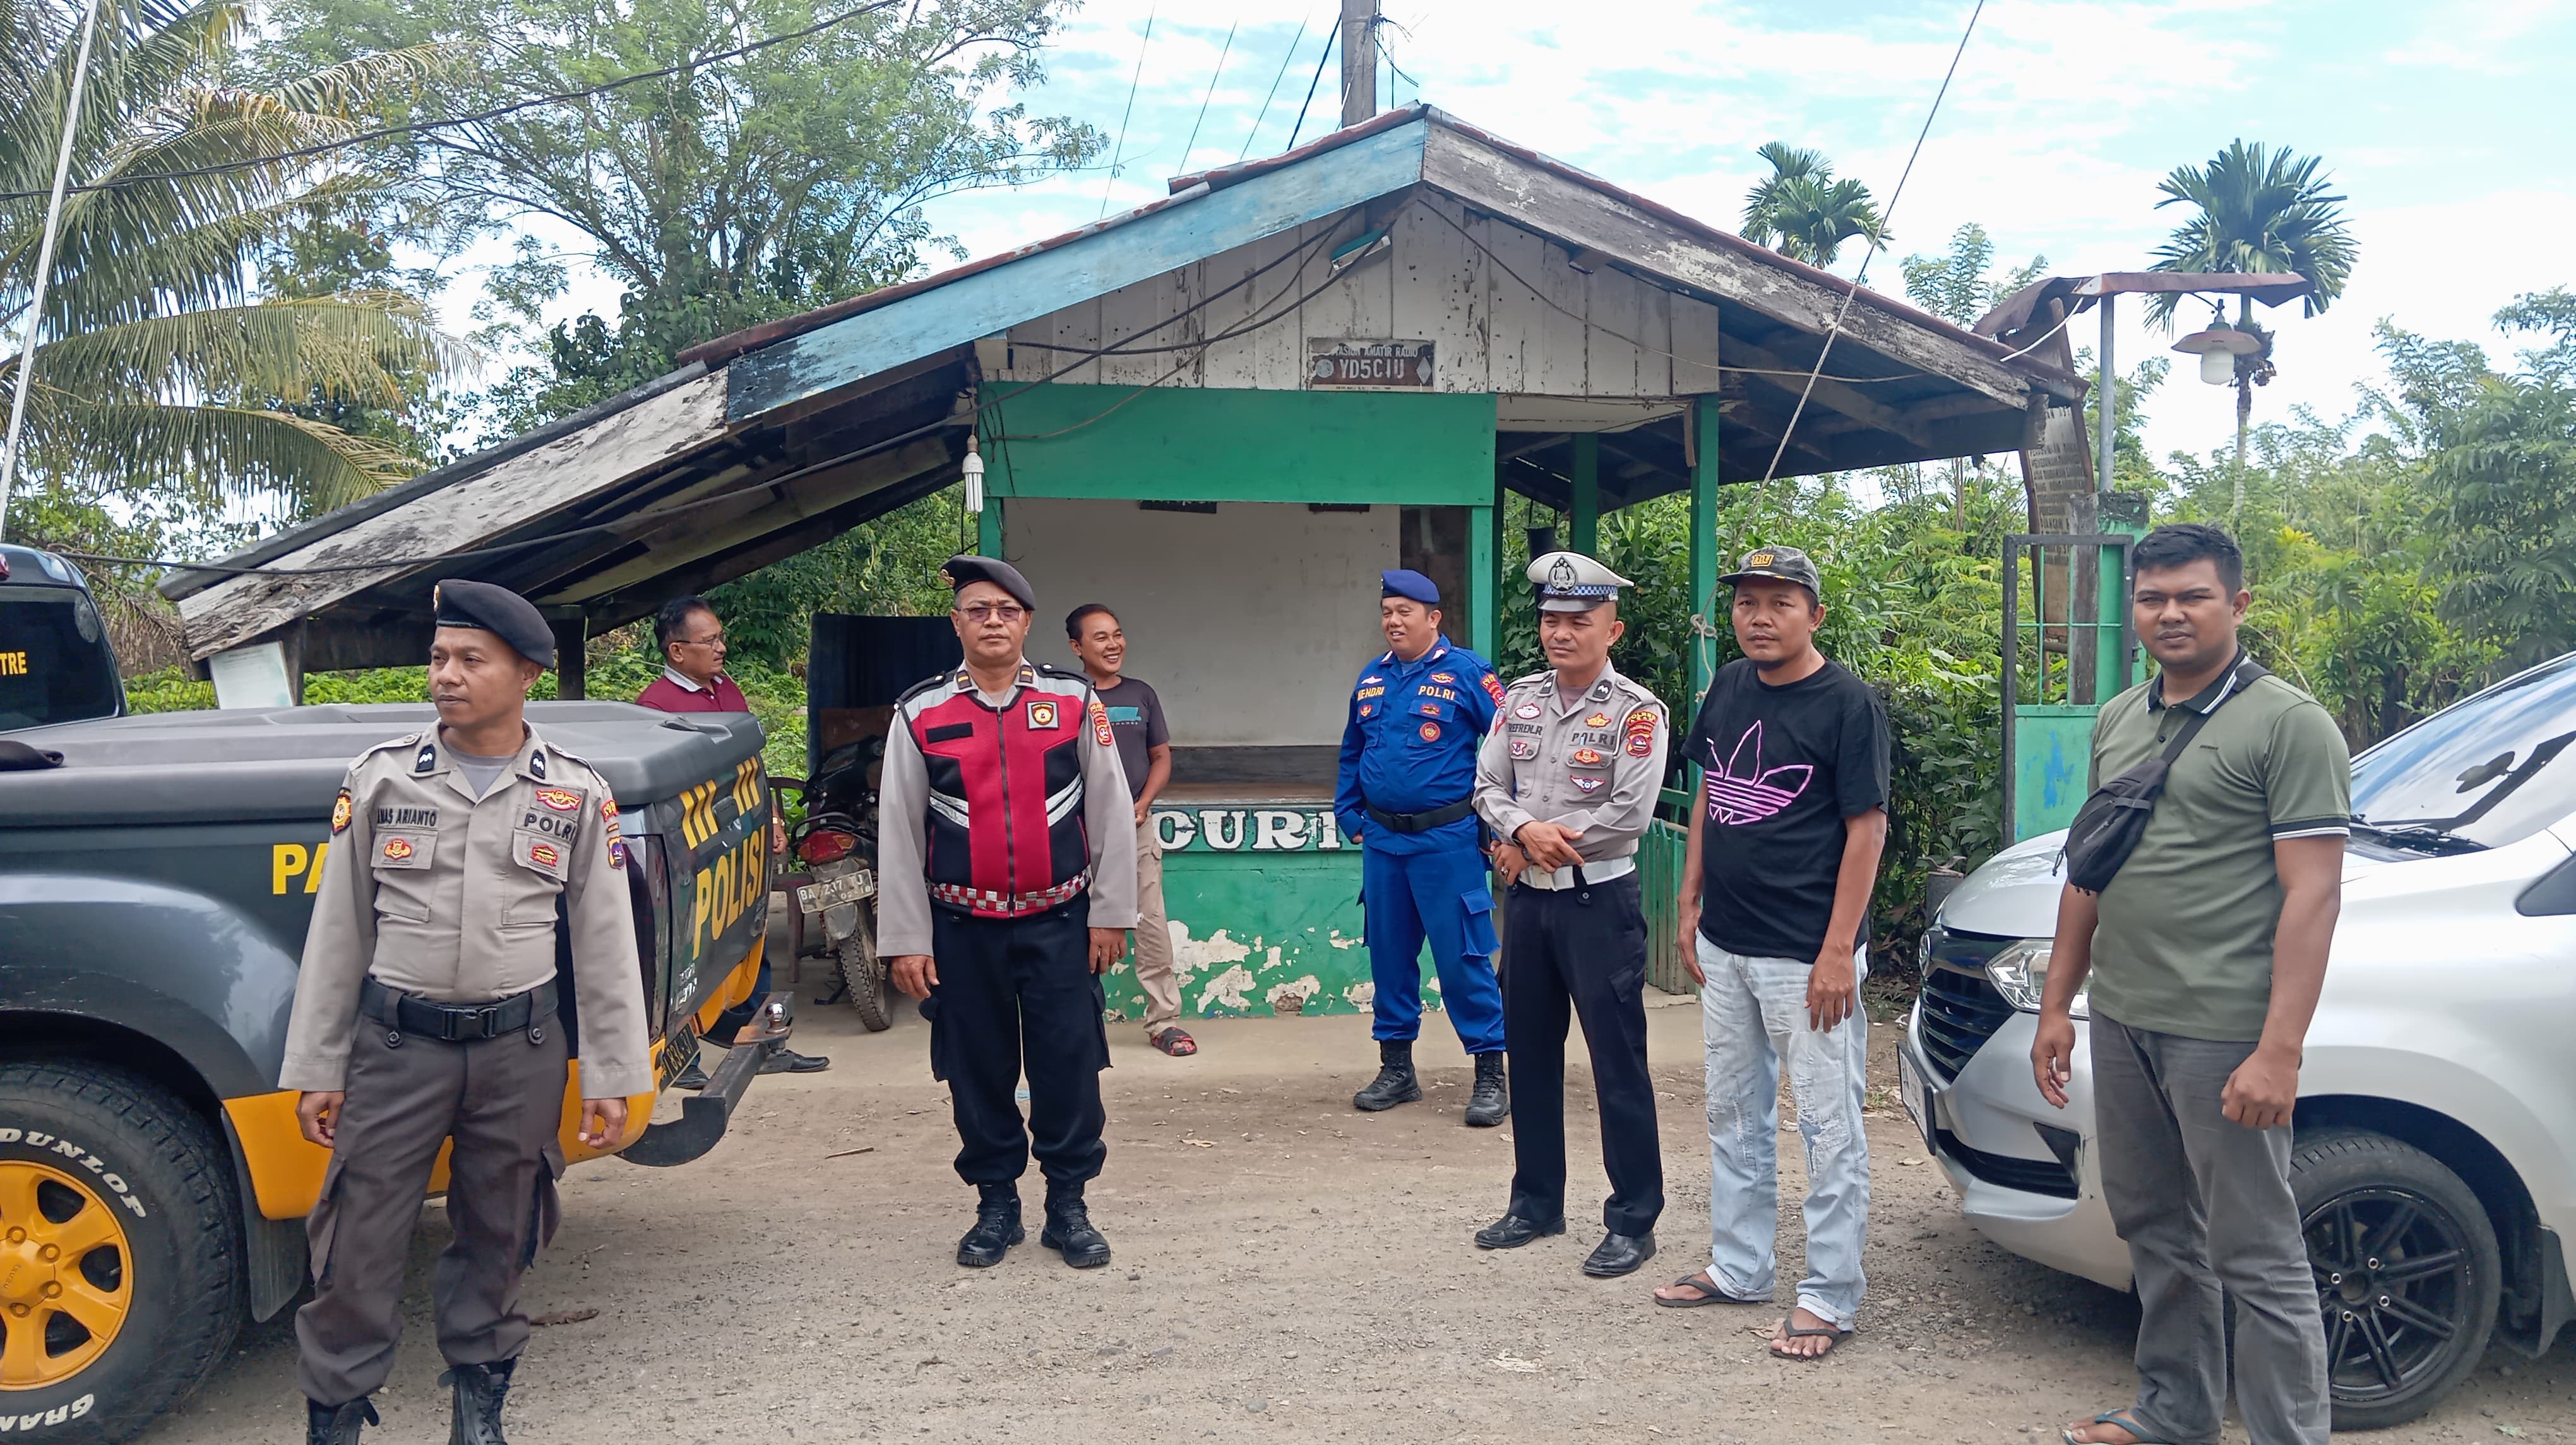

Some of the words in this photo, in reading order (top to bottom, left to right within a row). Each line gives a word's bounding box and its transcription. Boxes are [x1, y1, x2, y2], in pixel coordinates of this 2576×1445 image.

[1364, 347, 1392, 357] AMATIR
[1395, 347, 1418, 357] RADIO
[0, 652, 27, 675] TRE
[1418, 686, 1455, 700] POLRI
[1571, 732, 1615, 745] POLRI
[397, 808, 437, 827] ARIANTO
[524, 812, 576, 842] POLRI
[693, 824, 766, 961] POLISI
[799, 888, 816, 900] BA
[0, 1128, 146, 1218] DUNLOP
